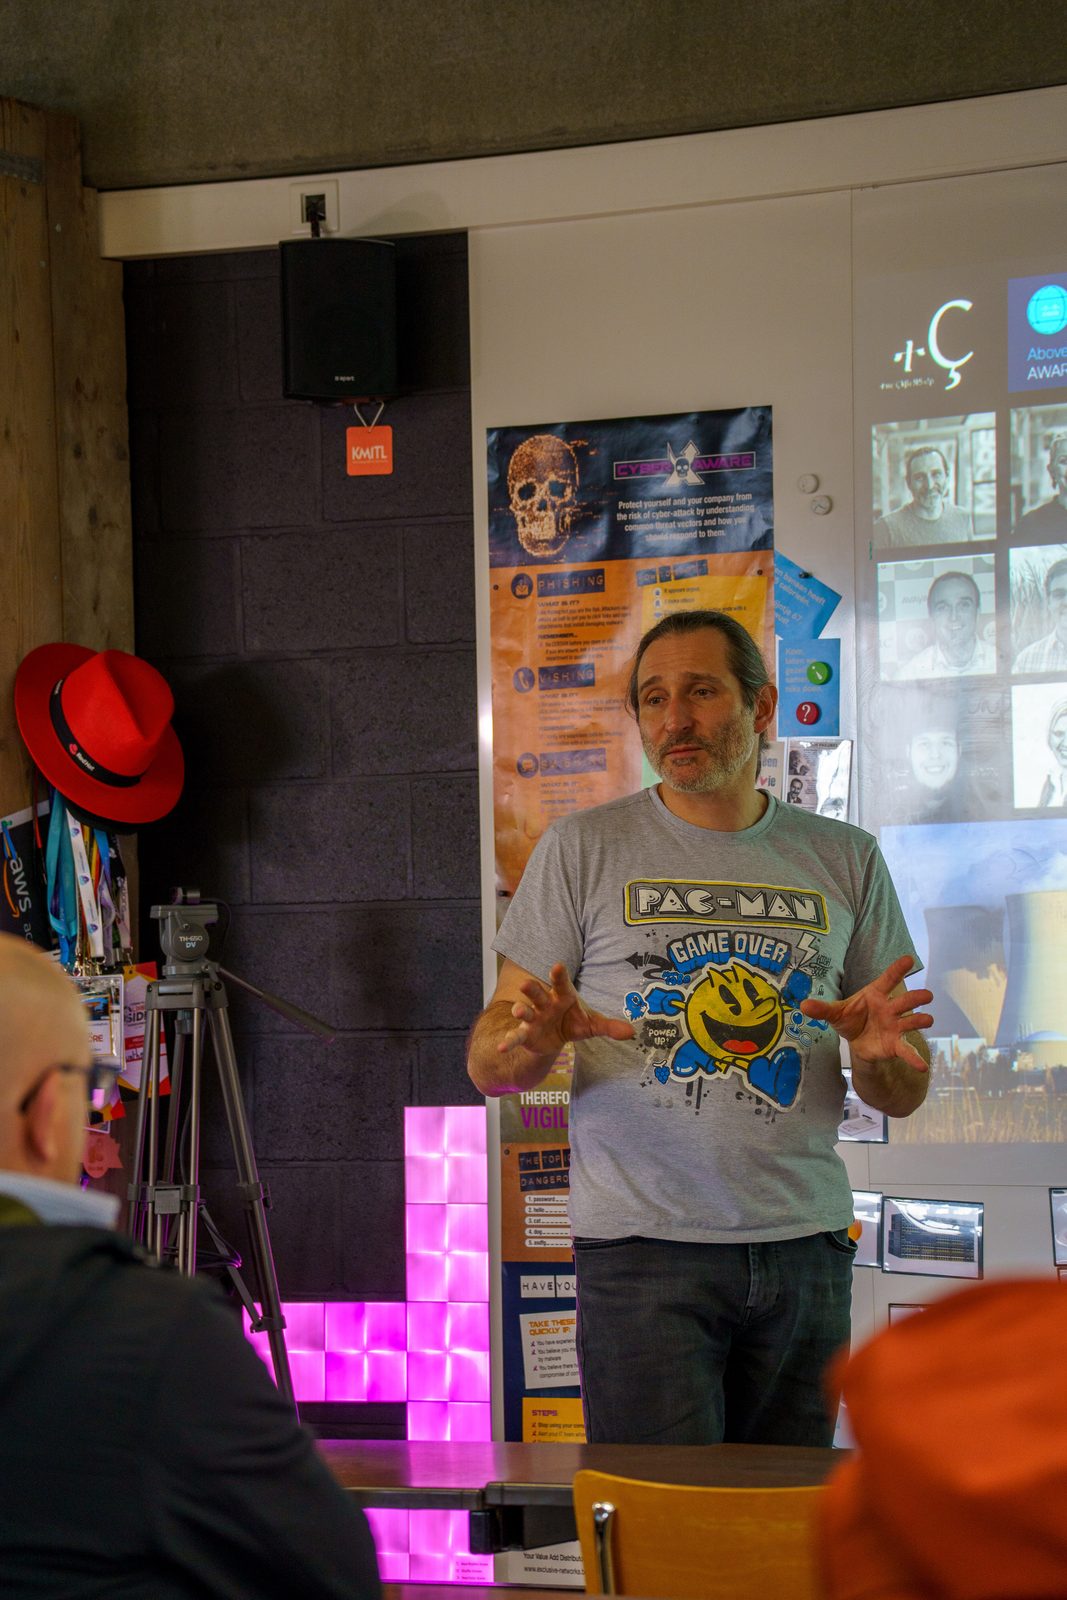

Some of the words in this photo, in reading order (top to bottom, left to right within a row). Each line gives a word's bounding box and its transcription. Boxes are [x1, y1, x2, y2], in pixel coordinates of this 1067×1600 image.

[617, 461, 672, 476] CYBER
[693, 455, 752, 470] AWARE
[618, 500, 642, 510] Protect
[644, 498, 671, 510] yourself
[672, 497, 686, 506] and
[687, 496, 702, 508] your
[703, 494, 734, 507] company
[735, 493, 752, 501] from
[616, 512, 628, 521] the
[628, 511, 642, 520] risk
[642, 510, 650, 519] of
[651, 507, 695, 520] cyber-attack
[696, 506, 705, 517] by
[706, 503, 755, 516] understanding
[624, 523, 654, 531] common
[655, 521, 676, 530] threat
[677, 519, 702, 529] vectors
[703, 518, 716, 526] and
[717, 516, 733, 525] how
[699, 530, 706, 538] to
[539, 575, 604, 590] PHISHING
[539, 669, 594, 684] VISHING
[10, 857, 32, 913] aws
[635, 886, 822, 924] PAC-MAN
[669, 931, 731, 966] GAME
[734, 932, 788, 965] OVER
[649, 1028, 677, 1038] POWER
[654, 1037, 666, 1046] UP
[519, 1091, 570, 1105] THEREFO
[520, 1106, 569, 1129] VIGIL
[520, 1156, 539, 1166] THE
[542, 1154, 561, 1164] TOP
[521, 1175, 569, 1187] DANGERO
[522, 1281, 553, 1291] HAVE
[528, 1320, 549, 1328] TAKE
[528, 1327, 560, 1336] QUICKLY
[532, 1409, 558, 1417] STEPS
[535, 1552, 548, 1560] Value
[549, 1553, 559, 1561] Add
